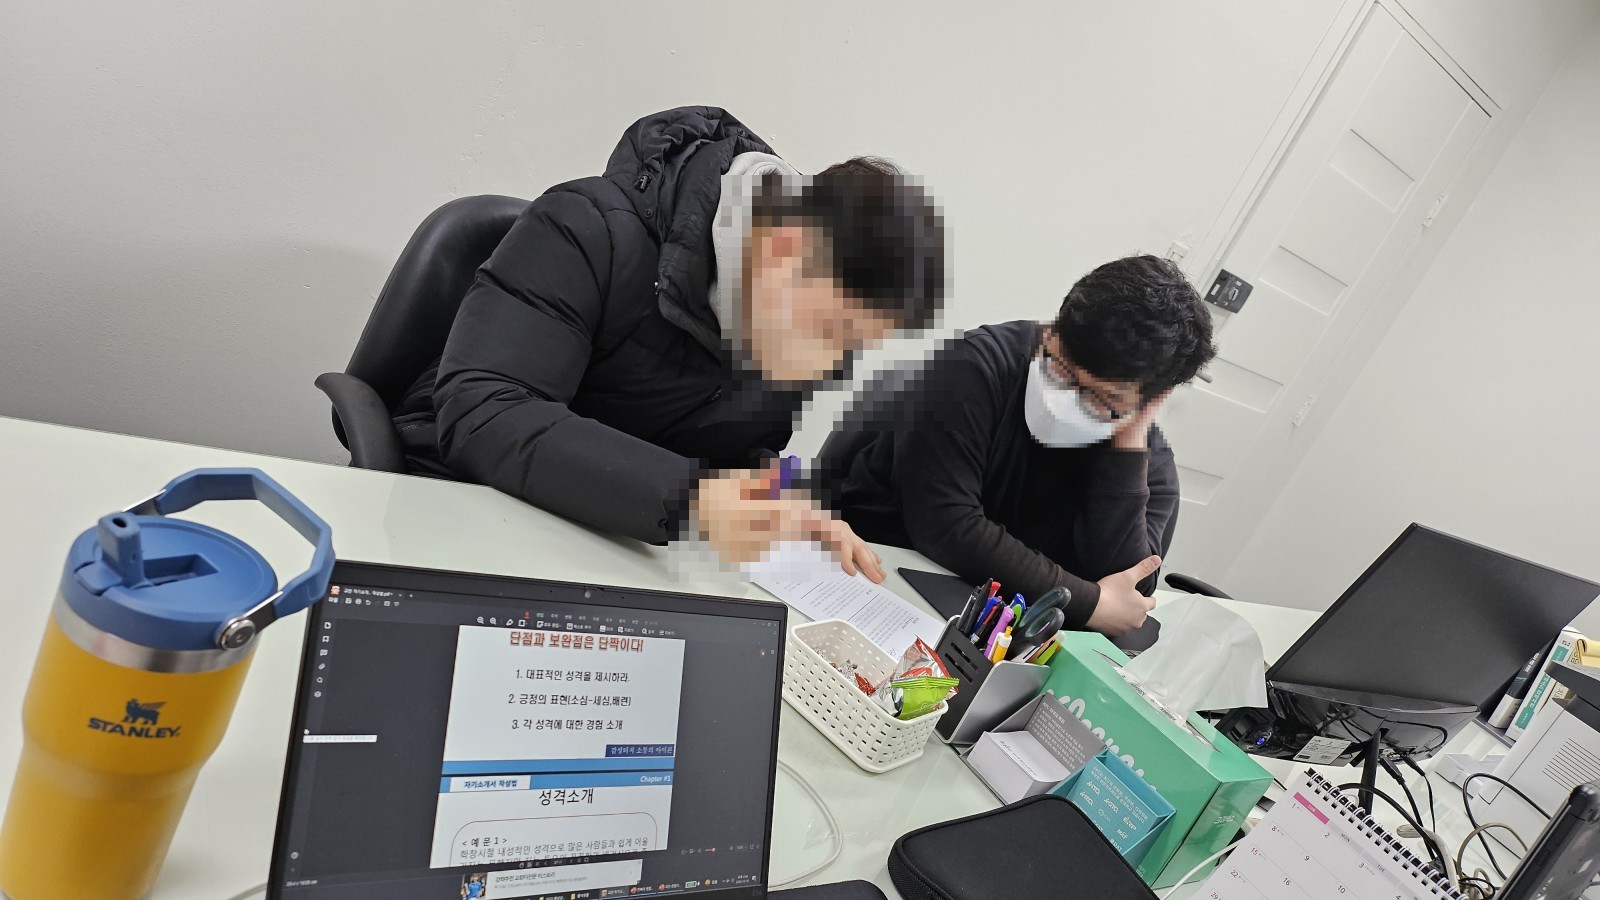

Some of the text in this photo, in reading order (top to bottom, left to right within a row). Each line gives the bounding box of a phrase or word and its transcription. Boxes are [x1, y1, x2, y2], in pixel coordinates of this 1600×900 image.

[510, 631, 644, 652] 단점과 보완점은 단짝이다!
[516, 669, 630, 682] 1. 대표적인 성격을 제시하라.
[508, 694, 516, 704] 2.
[519, 694, 547, 705] 긍정의
[88, 717, 181, 738] STANLEY
[512, 719, 623, 730] 3. 각 성격에 대한 경험 소개
[464, 779, 518, 788] 자기소개서 작성법
[538, 788, 594, 806] 성격소개
[471, 838, 480, 847] 예
[460, 837, 648, 860] 학창시절 내성적인 성격으로 많은 사람들과 쉽게 어울
[1250, 847, 1292, 886] 15 16
[1230, 870, 1239, 878] 22
[1338, 886, 1346, 894] 10
[1210, 892, 1218, 900] 29
